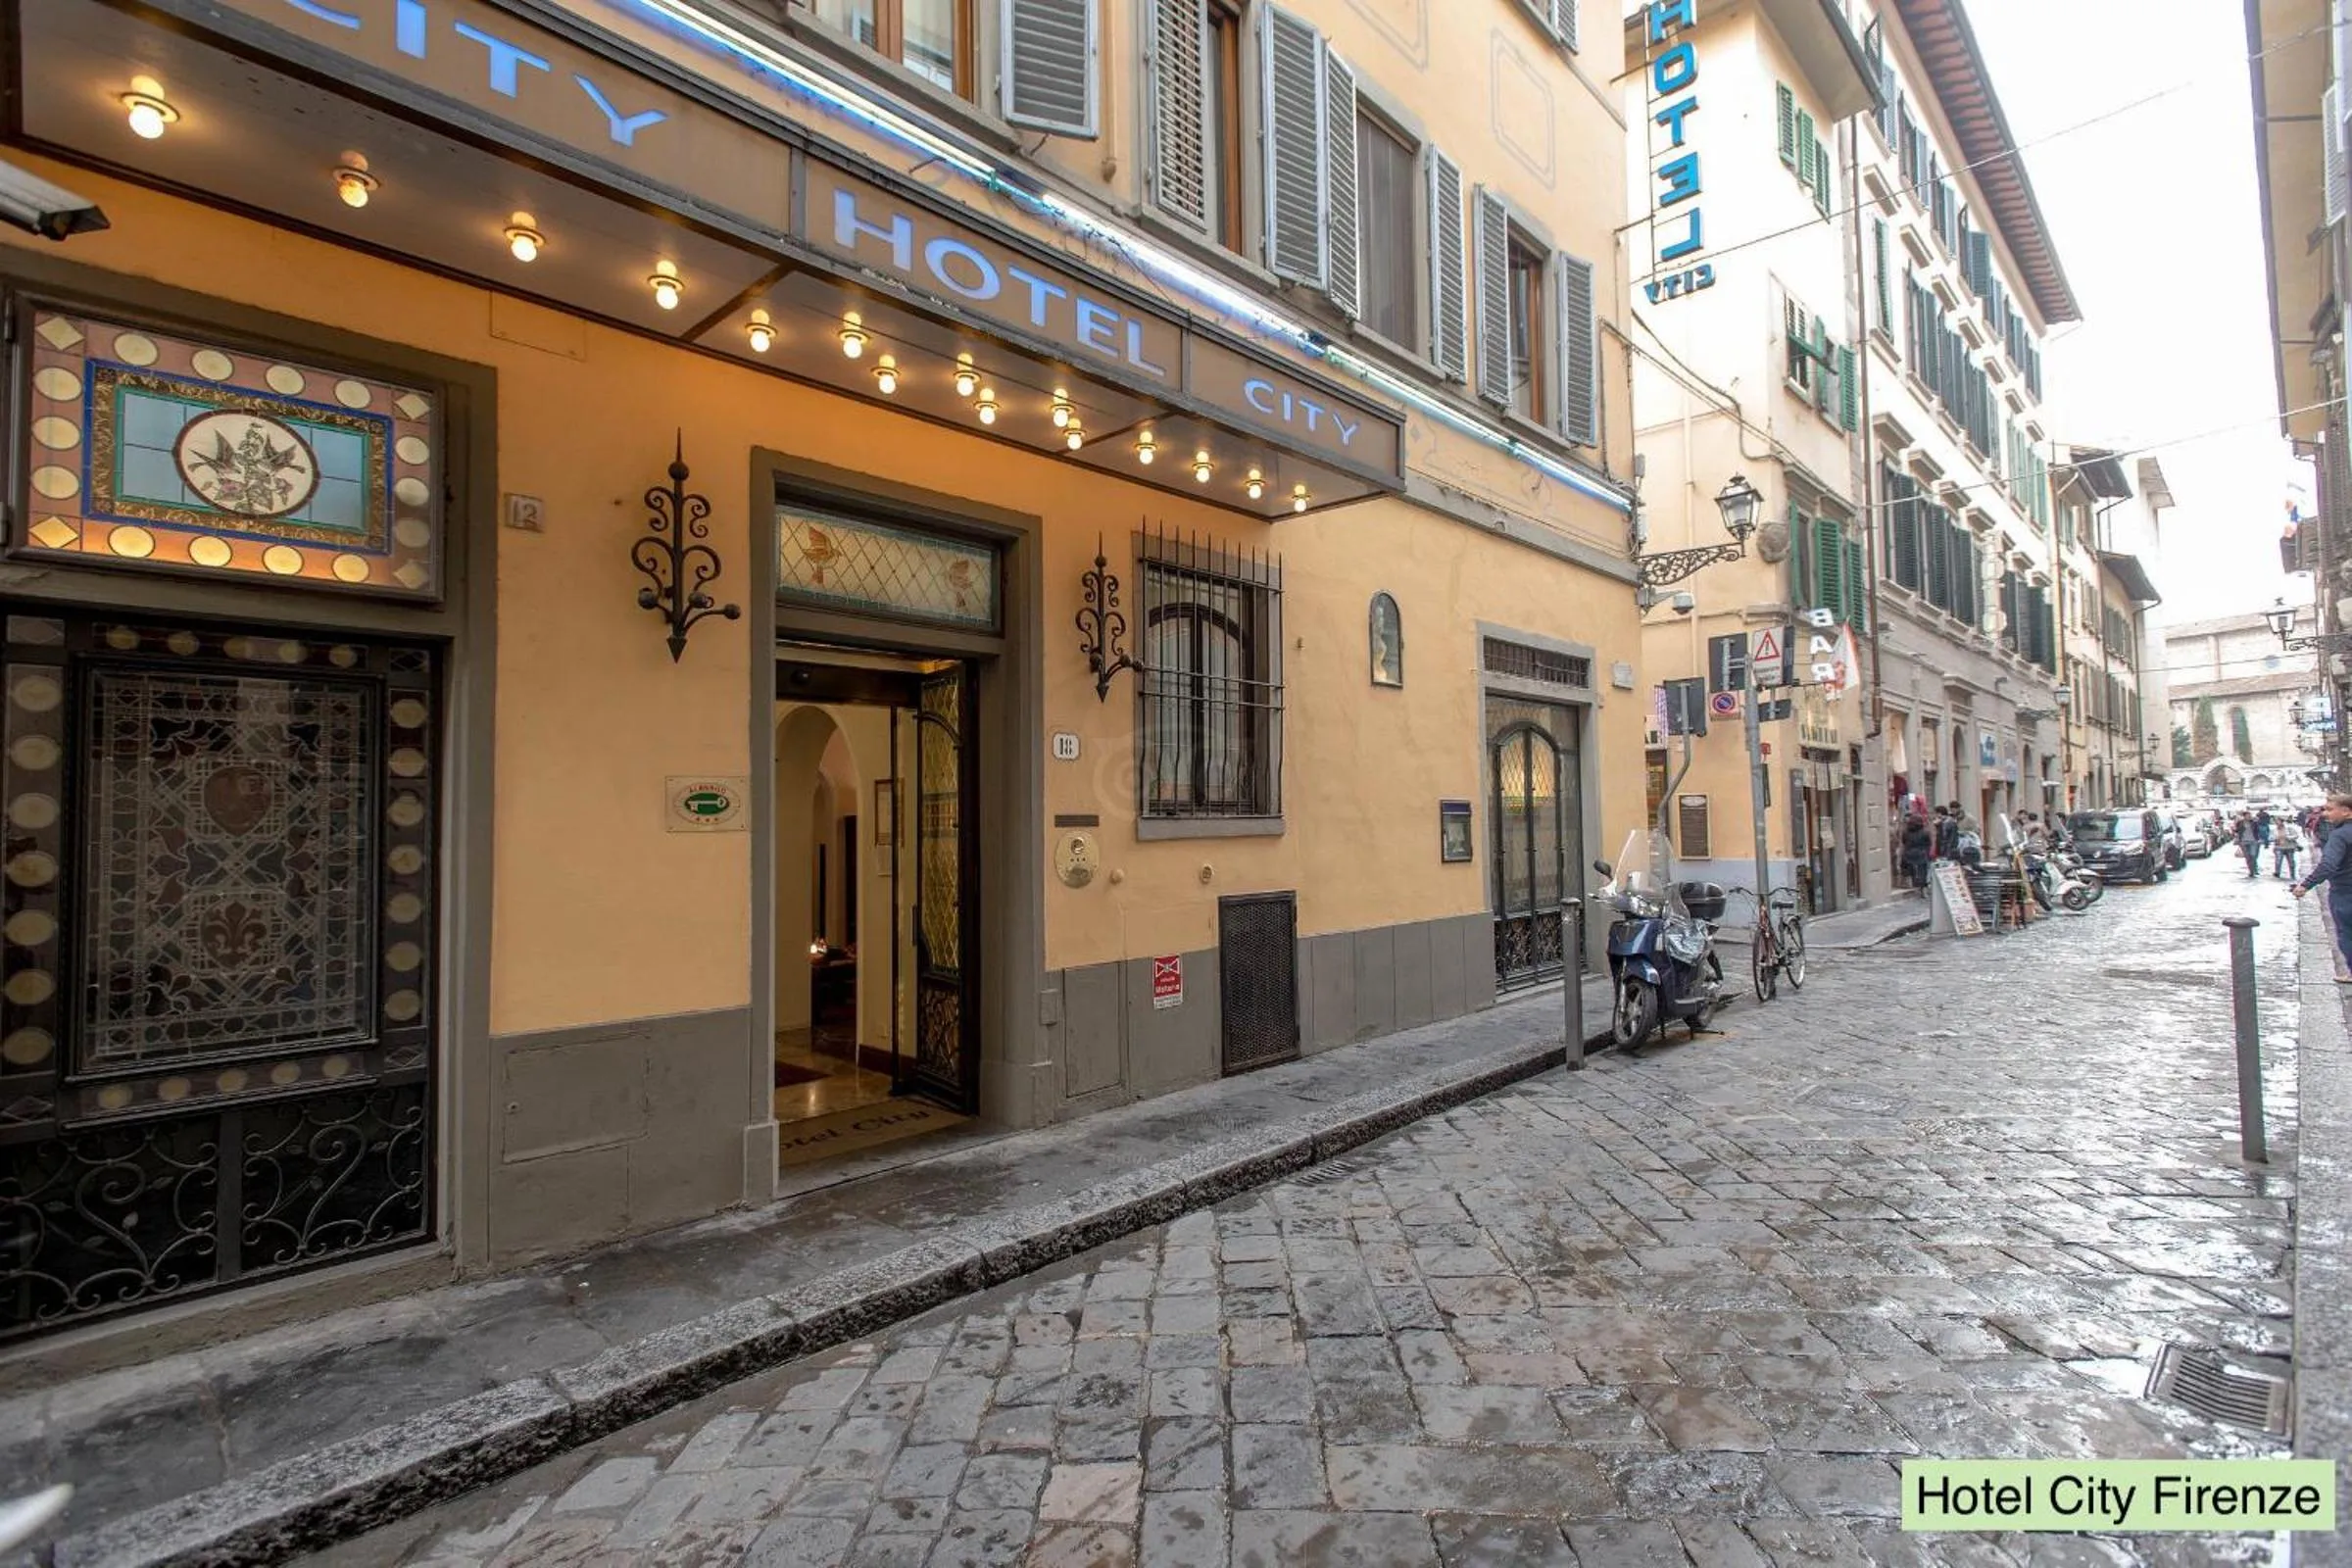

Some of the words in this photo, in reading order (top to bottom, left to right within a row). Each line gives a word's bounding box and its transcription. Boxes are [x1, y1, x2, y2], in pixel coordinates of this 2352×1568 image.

[283, 0, 669, 147] ITY
[832, 188, 1166, 378] HOTEL
[1243, 377, 1360, 447] CITY
[1058, 737, 1073, 756] 18
[780, 1128, 840, 1150] otel
